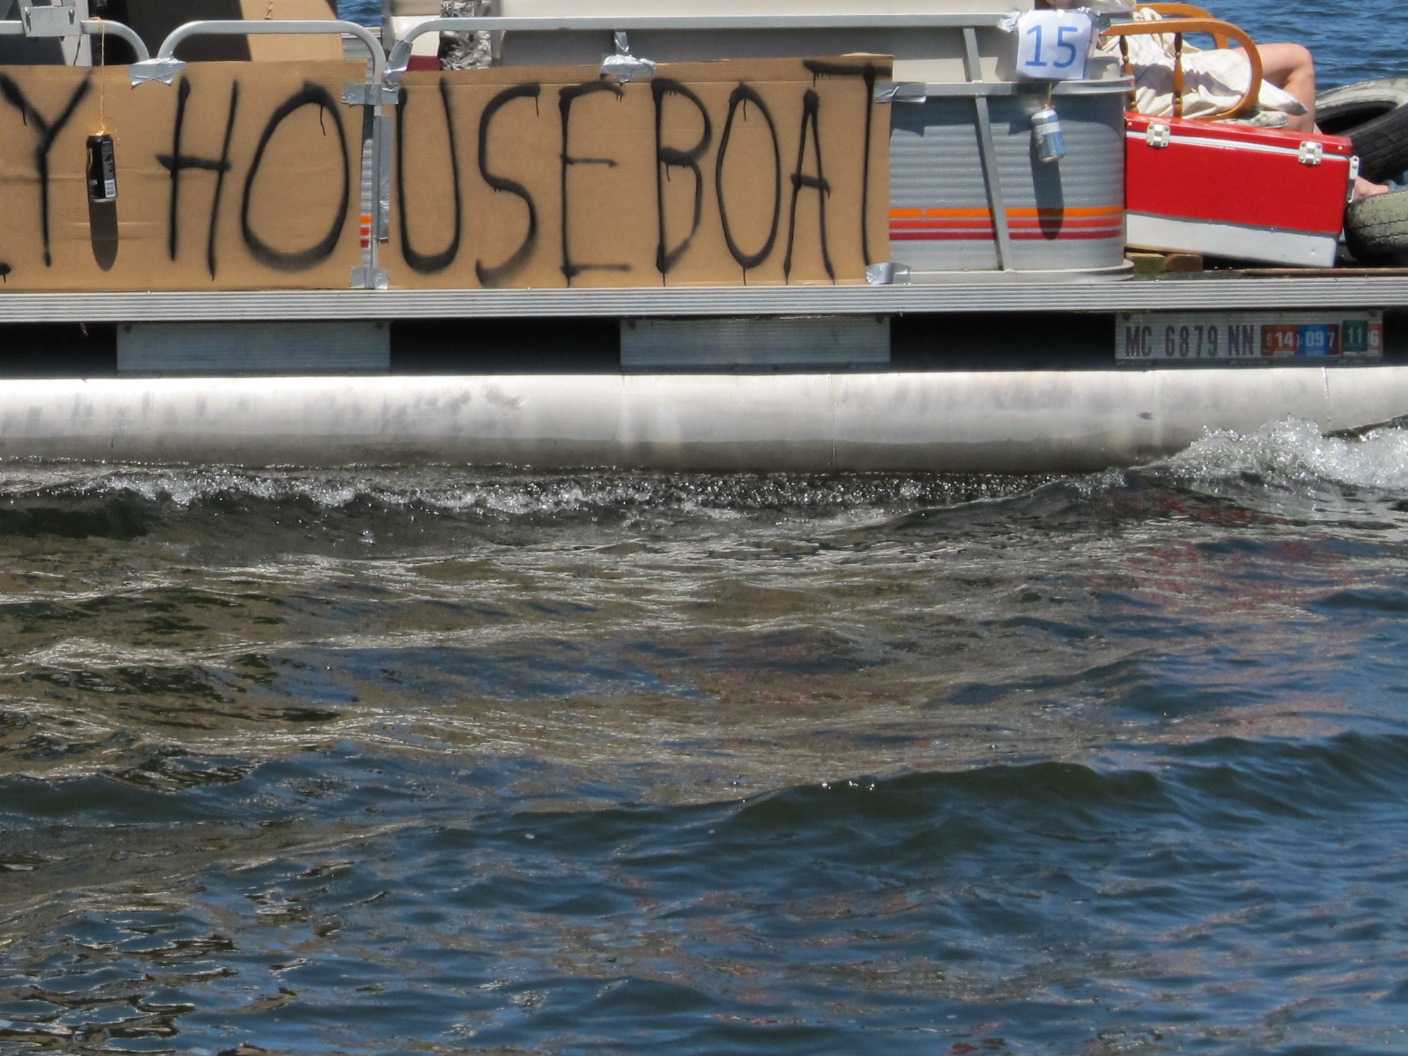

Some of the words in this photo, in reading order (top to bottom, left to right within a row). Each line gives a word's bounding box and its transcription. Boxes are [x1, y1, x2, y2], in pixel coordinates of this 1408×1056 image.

[1023, 24, 1080, 69] 15
[155, 58, 893, 288] HOUSEBOAT
[1125, 325, 1152, 357] MC
[1165, 325, 1219, 357] 6879
[1228, 324, 1254, 356] NN
[1274, 331, 1294, 348] 14
[1305, 330, 1325, 348] 09
[1347, 326, 1363, 344] 11
